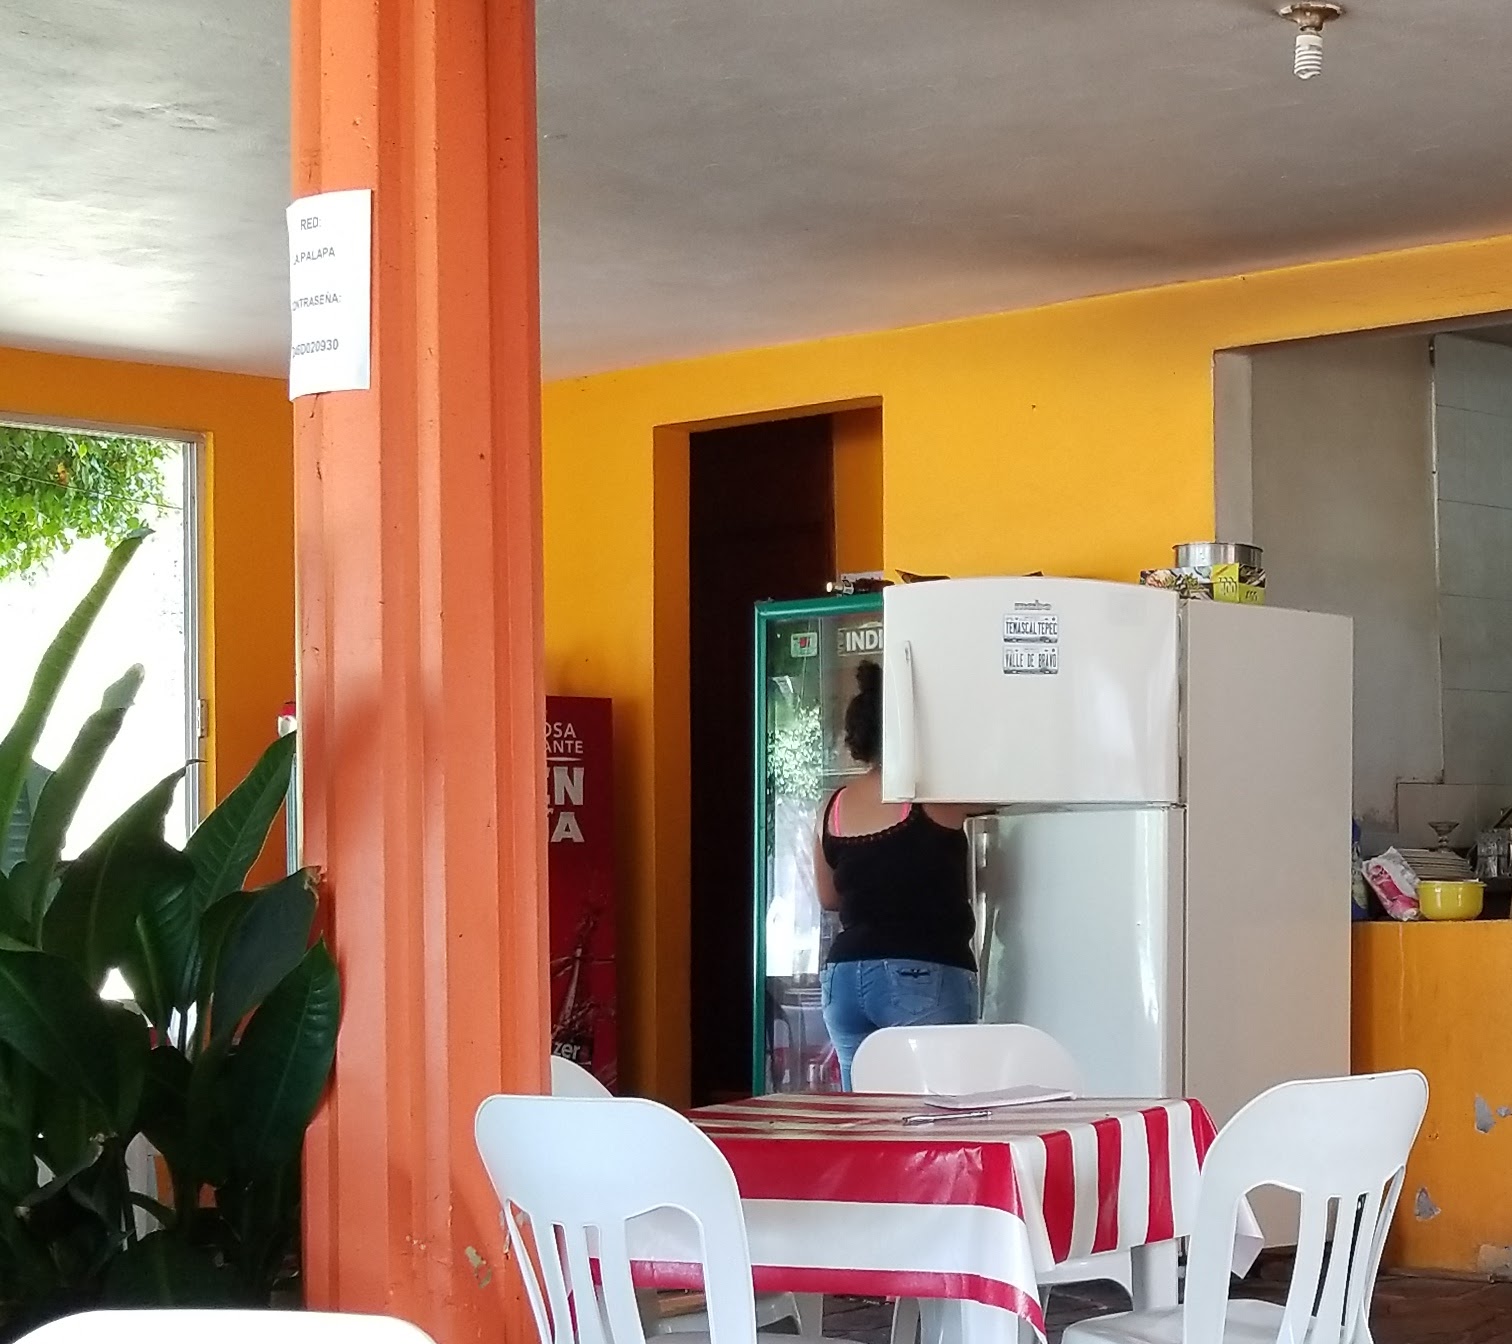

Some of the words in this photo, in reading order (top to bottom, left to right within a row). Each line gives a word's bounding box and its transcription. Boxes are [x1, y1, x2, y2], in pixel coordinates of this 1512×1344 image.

[300, 216, 322, 231] RED:
[1005, 653, 1024, 668] VALLE
[1027, 653, 1035, 668] DE
[1038, 653, 1057, 668] BRAVO
